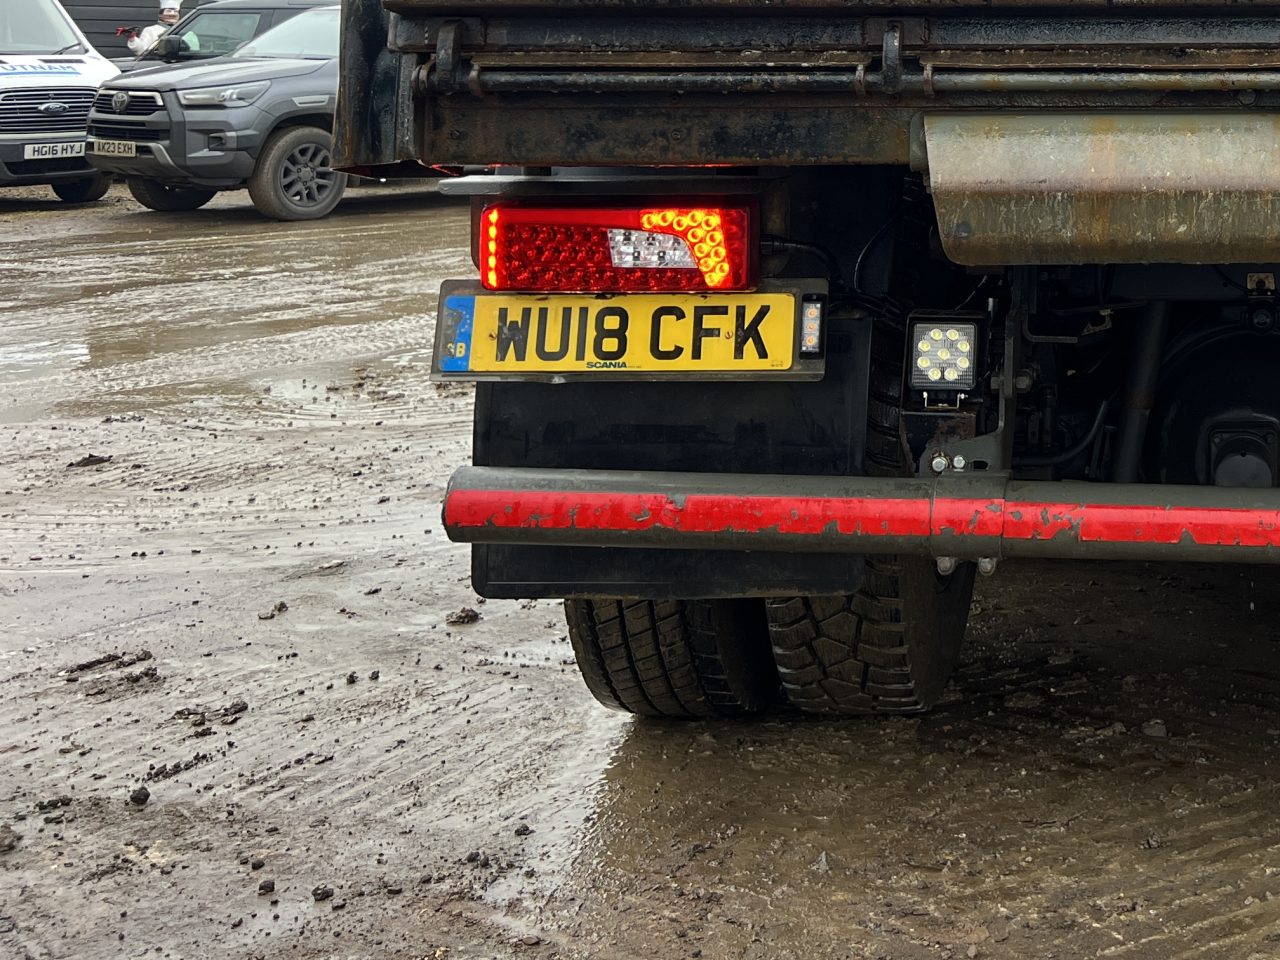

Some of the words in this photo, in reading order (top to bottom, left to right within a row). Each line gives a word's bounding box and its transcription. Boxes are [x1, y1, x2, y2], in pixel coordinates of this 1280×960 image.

[32, 145, 58, 157] HG16
[61, 144, 82, 155] HYJ
[117, 142, 133, 154] EXH
[495, 306, 629, 362] WU18
[650, 305, 771, 361] CFK
[586, 361, 627, 369] SCANIA
